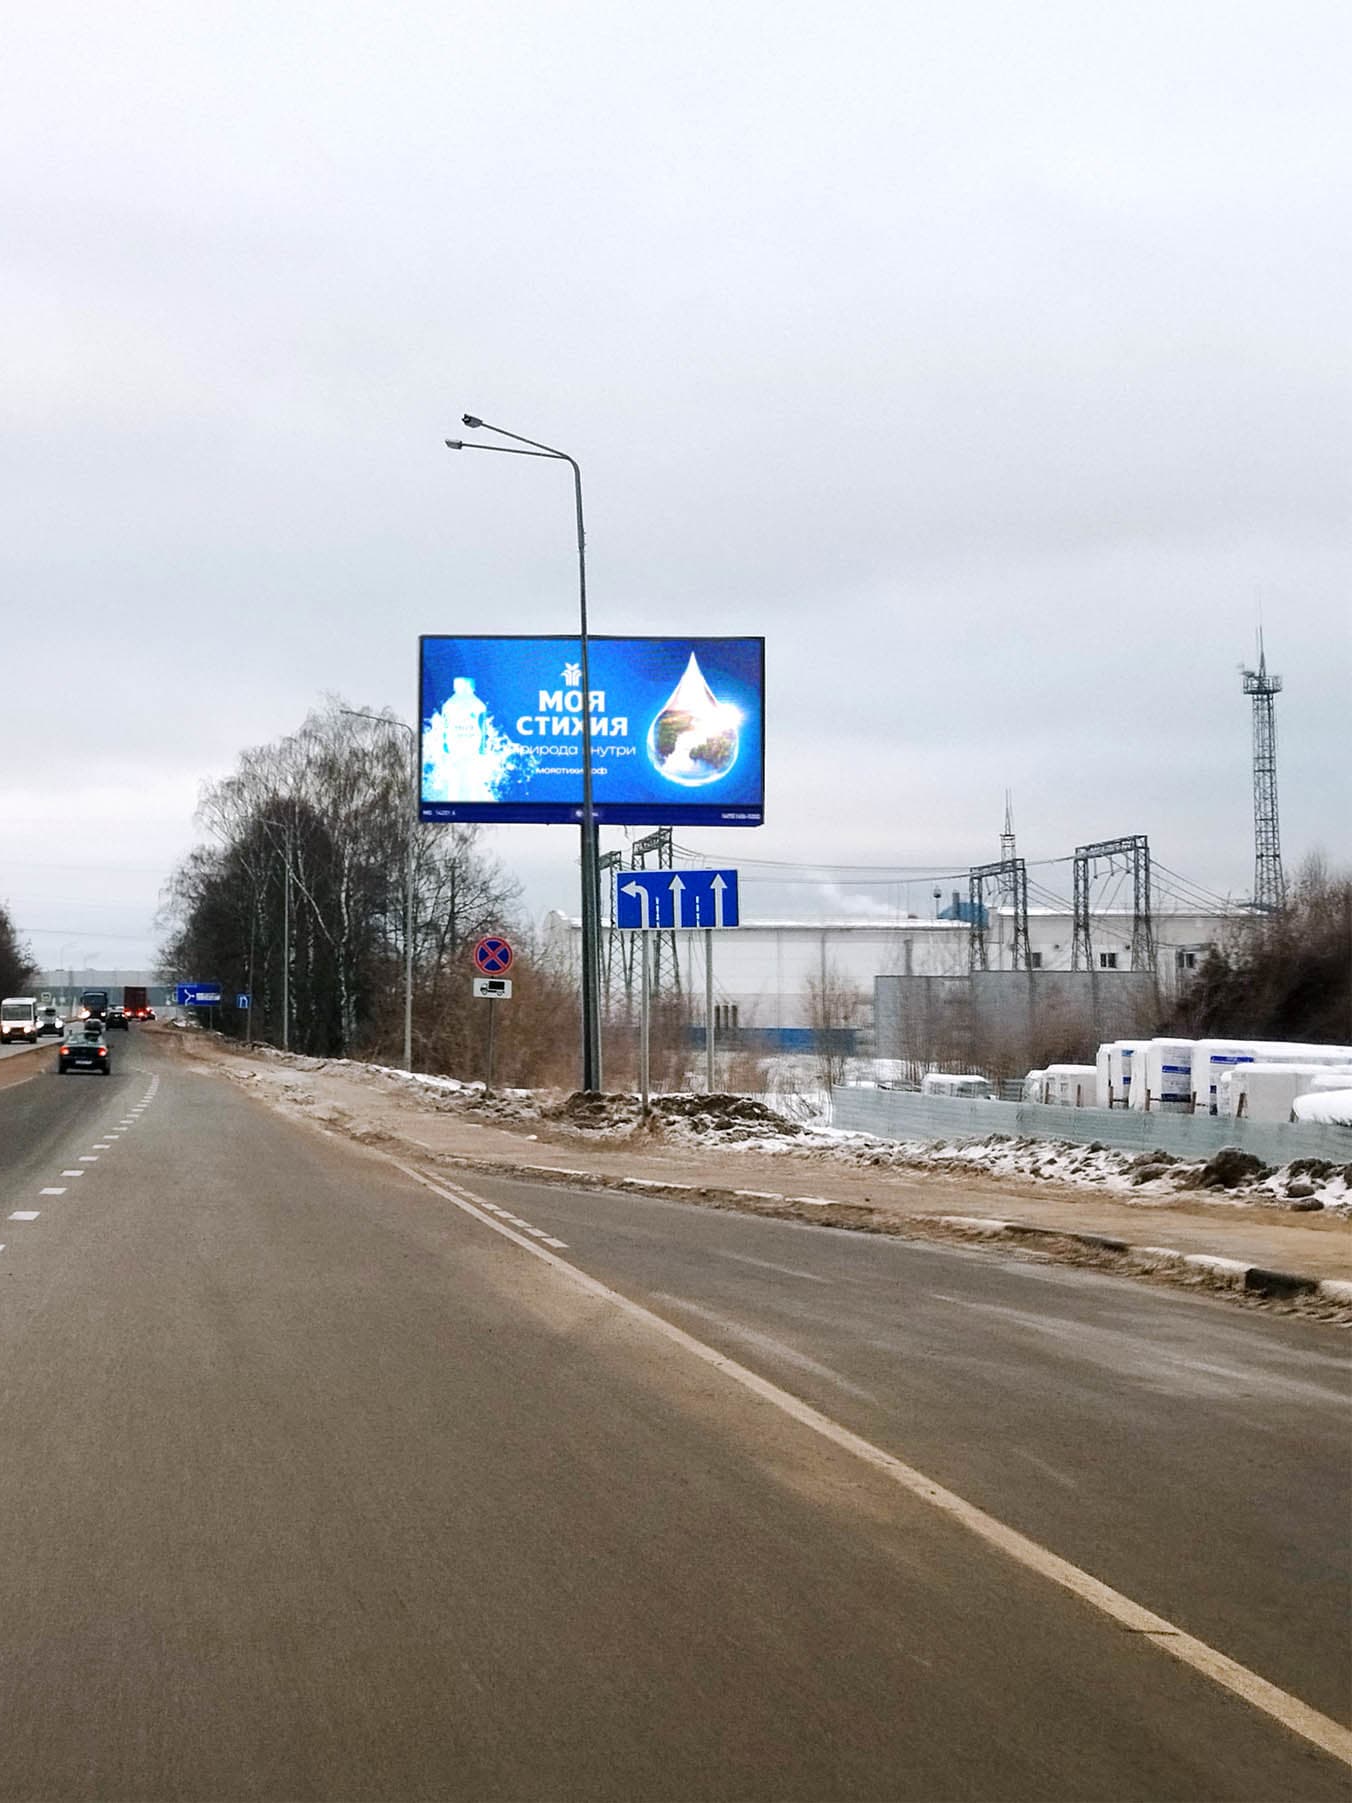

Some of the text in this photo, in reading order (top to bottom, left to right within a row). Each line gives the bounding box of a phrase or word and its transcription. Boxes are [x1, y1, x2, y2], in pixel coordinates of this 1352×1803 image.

[538, 690, 605, 713] МОЯ
[516, 715, 628, 736] СТИХИЯ
[515, 744, 636, 758] рирода нутри
